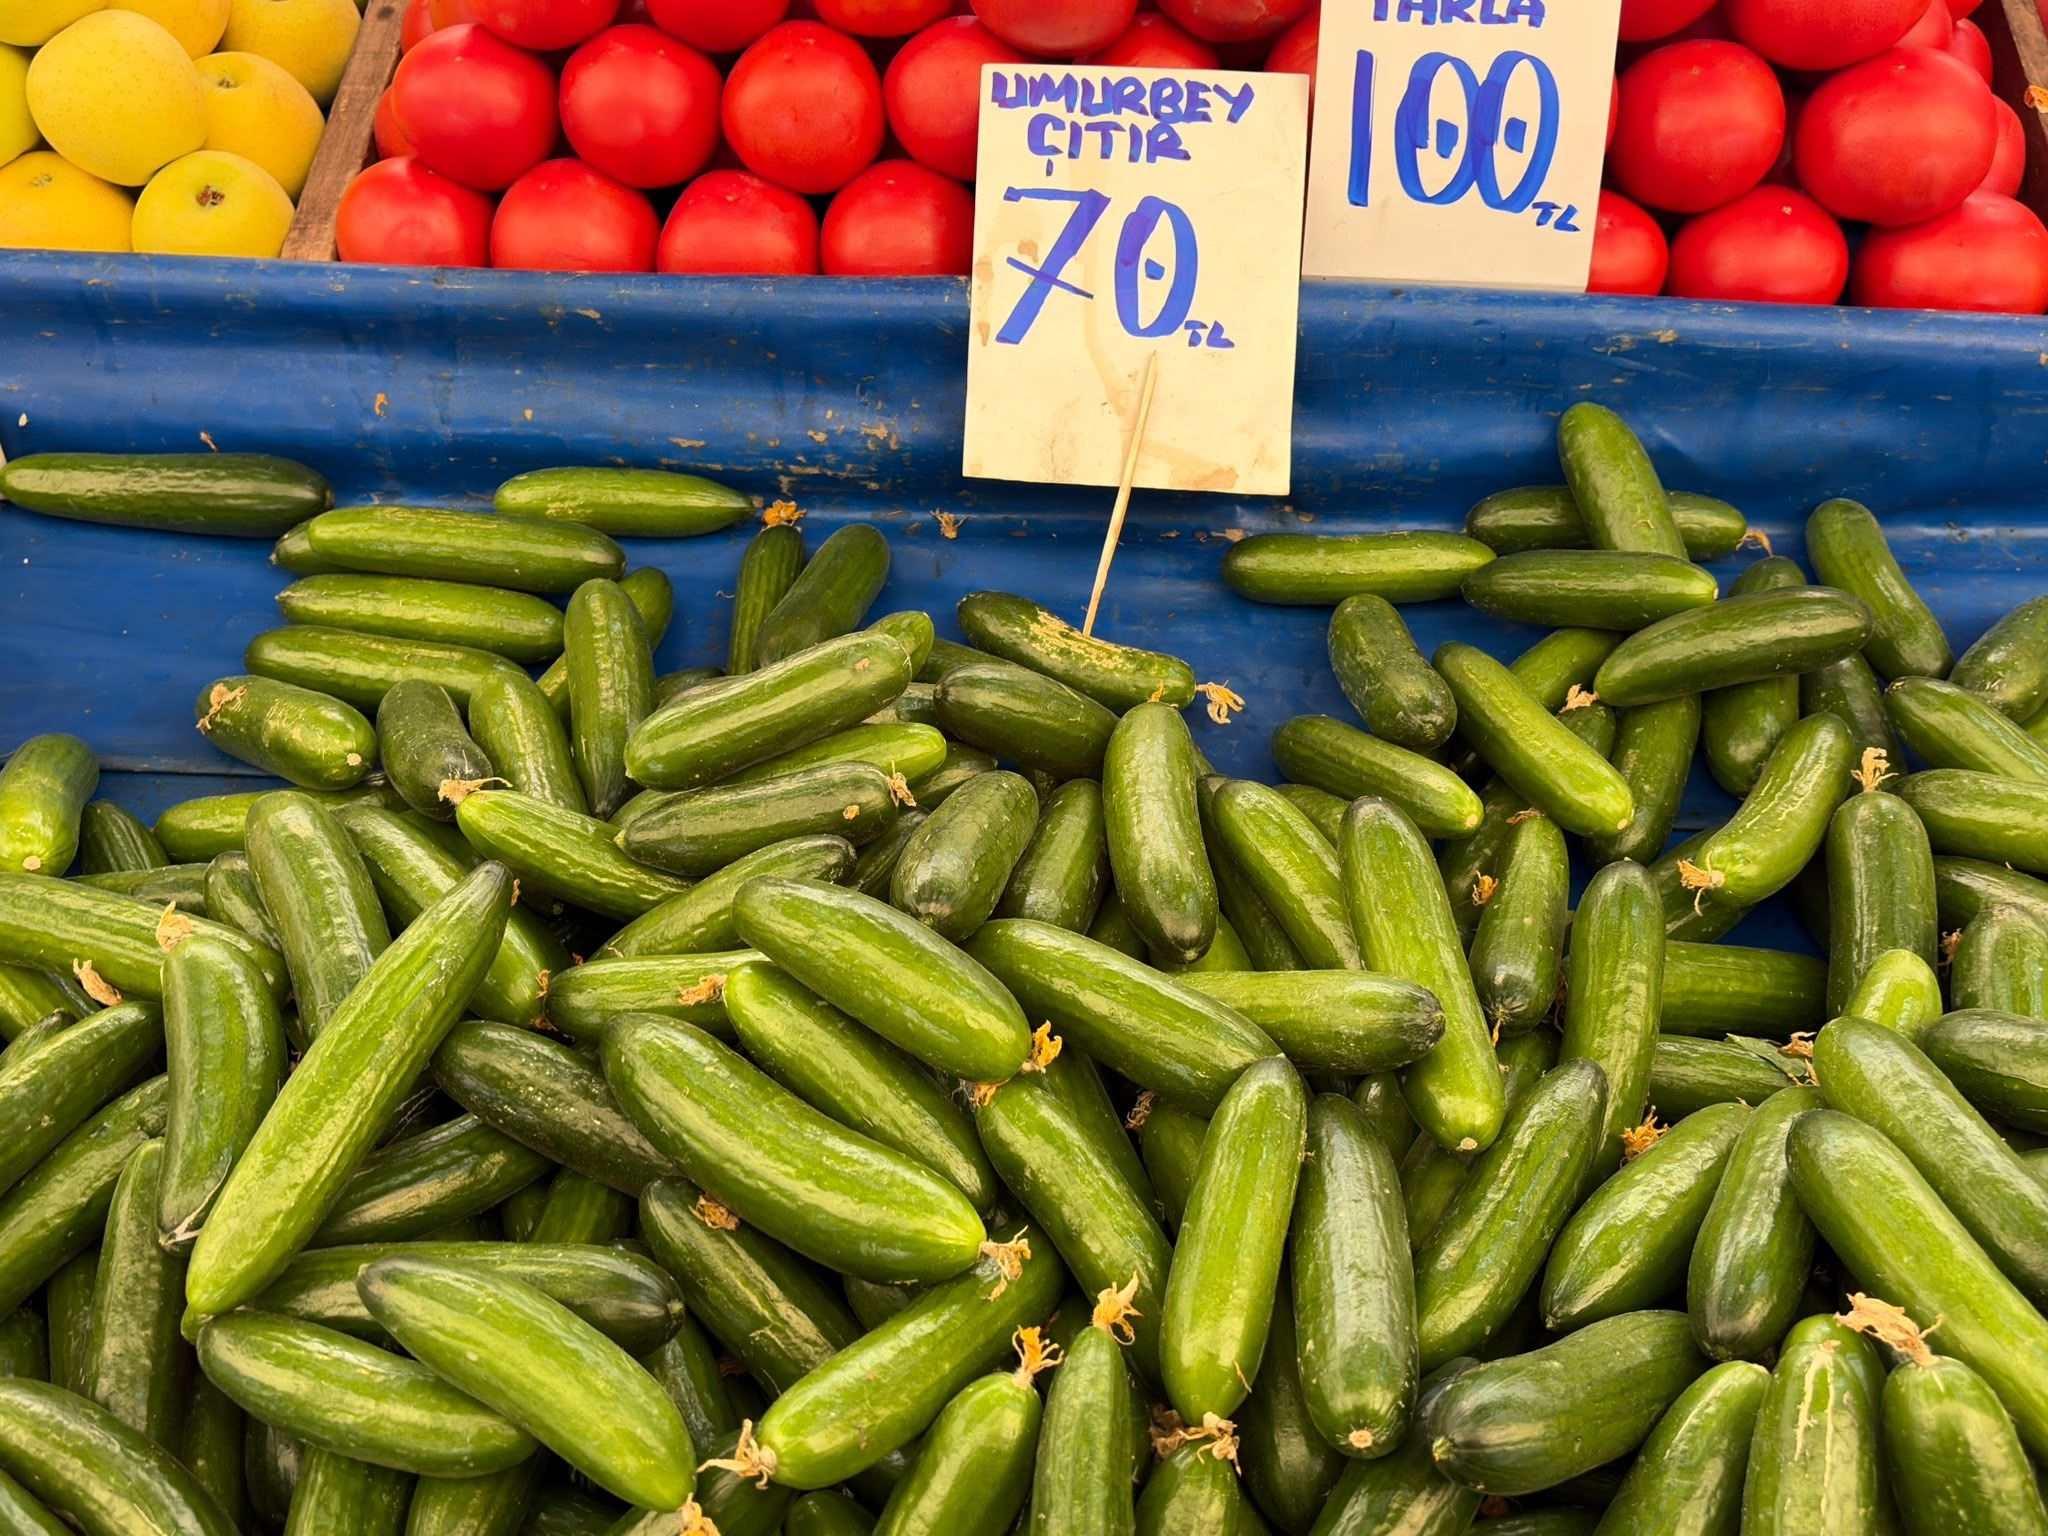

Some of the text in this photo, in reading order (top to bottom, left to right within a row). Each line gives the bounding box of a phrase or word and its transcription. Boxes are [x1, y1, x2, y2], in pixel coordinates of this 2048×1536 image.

[991, 72, 1255, 124] UMURBEY
[1347, 50, 1581, 232] 100 TL
[995, 187, 1235, 349] 70 TL
